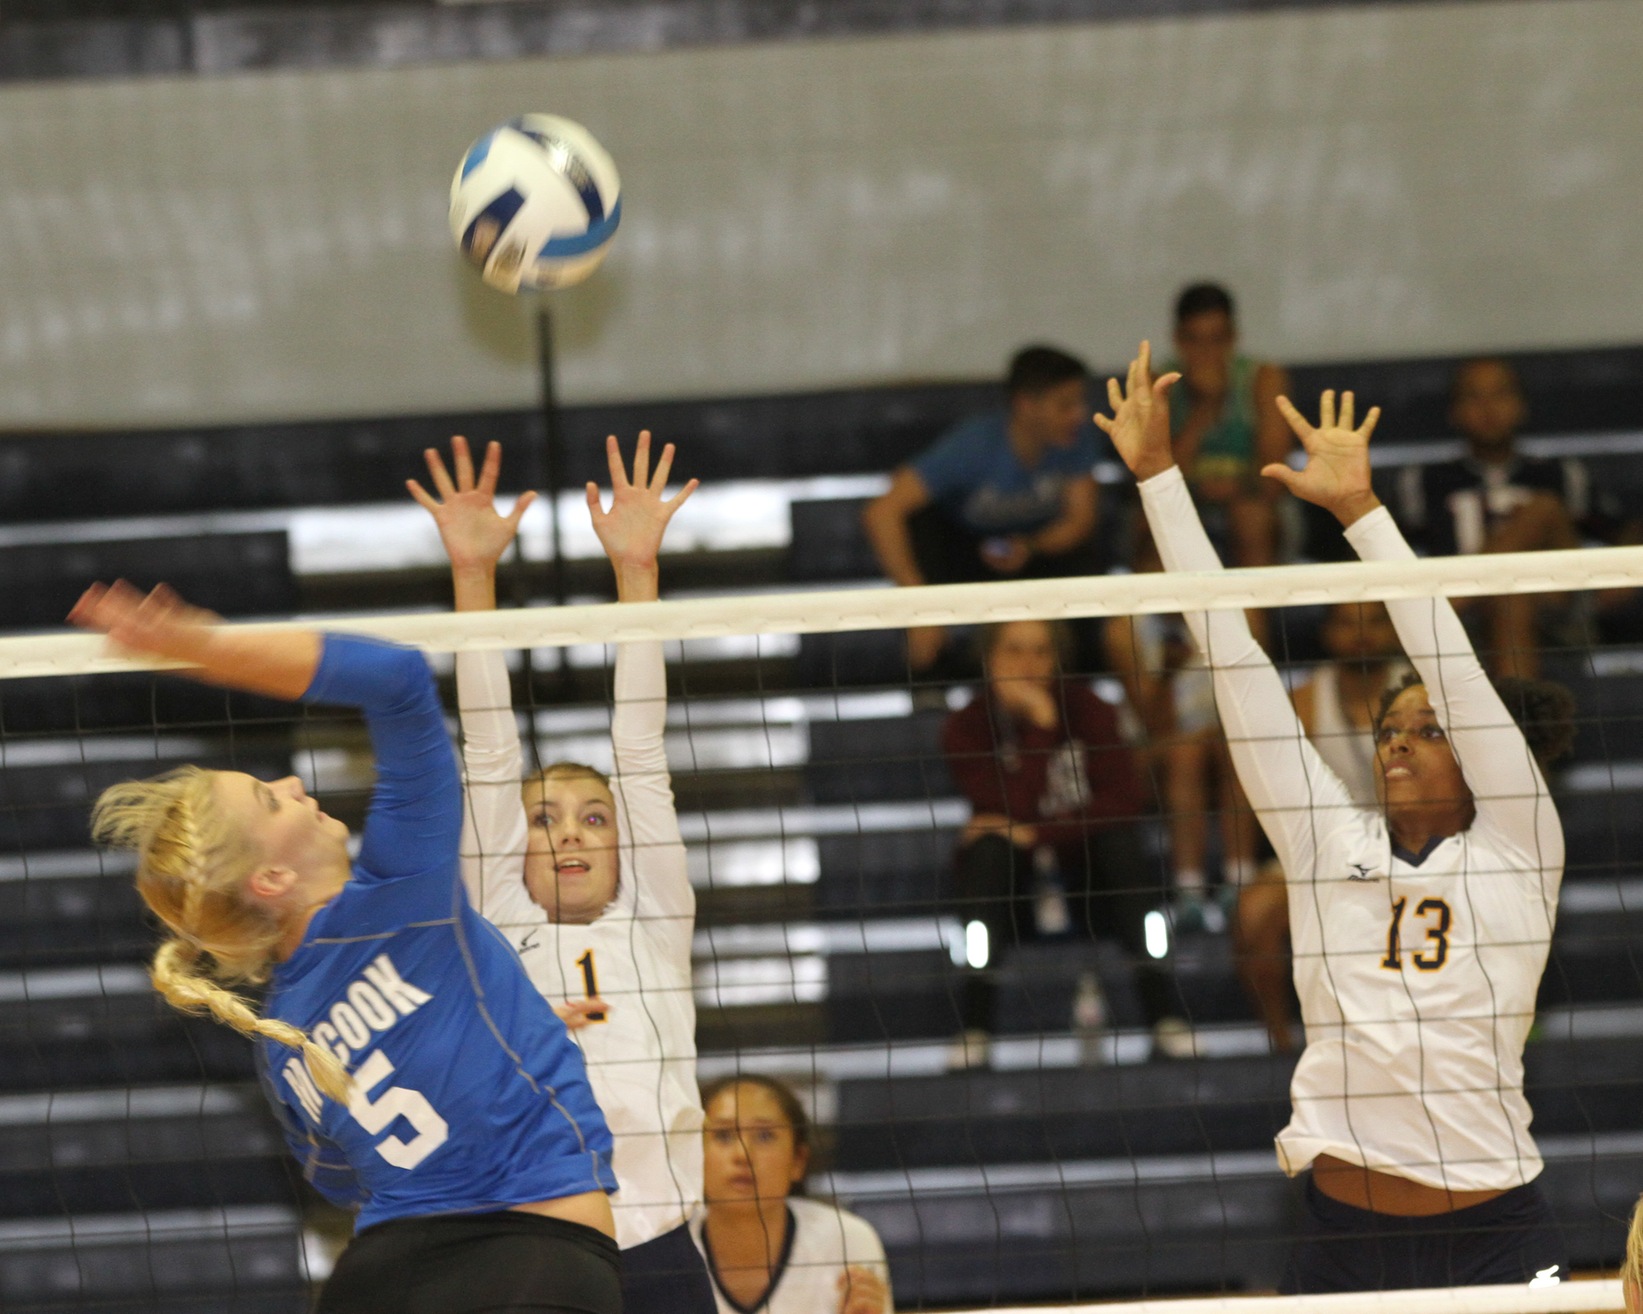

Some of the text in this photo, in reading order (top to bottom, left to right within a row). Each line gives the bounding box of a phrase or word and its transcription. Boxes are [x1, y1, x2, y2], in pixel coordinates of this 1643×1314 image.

[1380, 896, 1453, 973] 13
[575, 948, 608, 1023] 1
[281, 952, 434, 1125] MCOOK
[348, 1049, 448, 1170] 5
